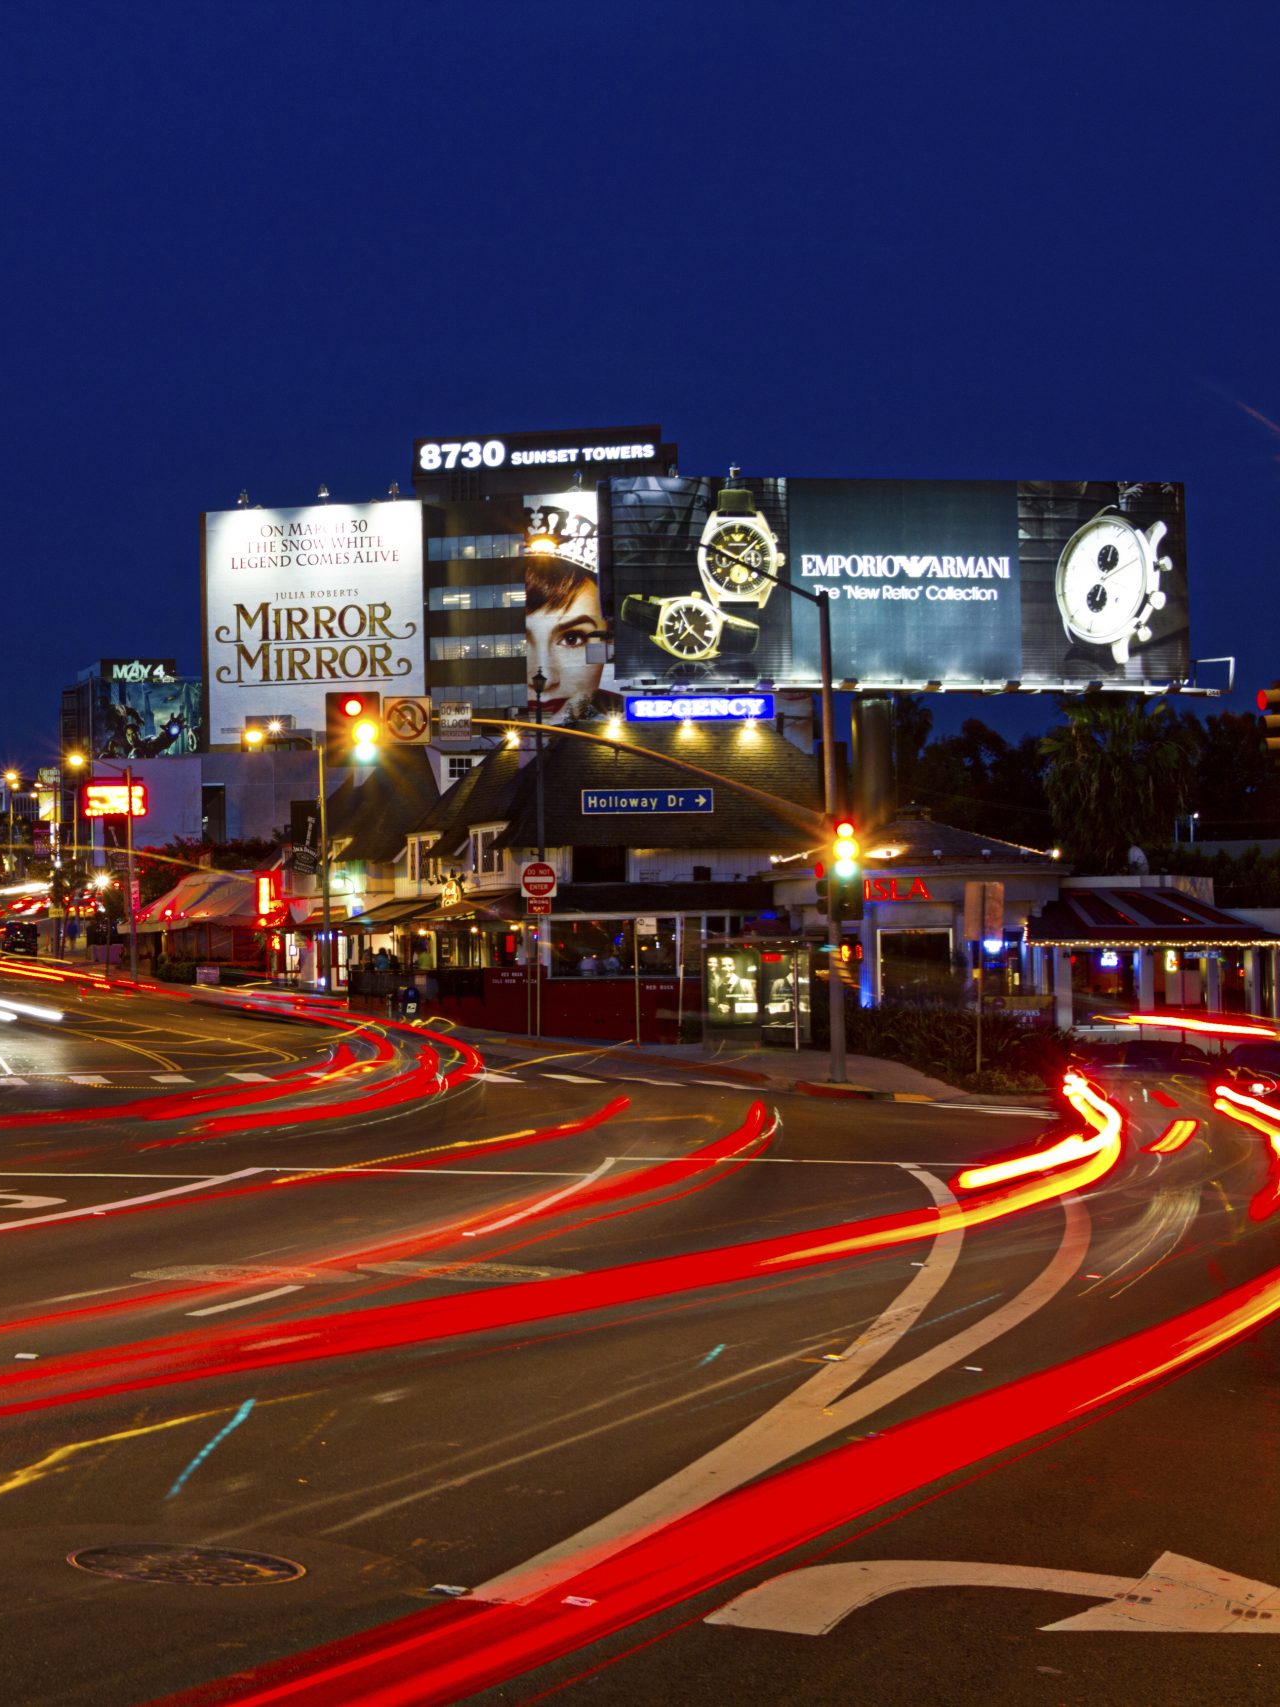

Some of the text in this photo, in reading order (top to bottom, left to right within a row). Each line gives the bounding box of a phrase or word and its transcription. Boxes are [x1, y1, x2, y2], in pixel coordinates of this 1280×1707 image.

[420, 440, 655, 470] 8730 SUNSET TOWERS
[260, 524, 284, 537] ON
[350, 519, 368, 533] 30
[246, 535, 384, 553] THE SNOW WHITE
[231, 550, 400, 570] LEGEND COMES ALIVE
[801, 555, 1010, 578] EMPORIO ARMANI
[275, 588, 360, 601] JULIA ROBERTS
[925, 584, 998, 600] Collection
[215, 601, 417, 643] MIRROR
[113, 660, 165, 682] MAY 4
[216, 642, 412, 683] MIRROR
[455, 706, 470, 716] NOT
[635, 699, 765, 717] REGENCY
[441, 719, 470, 728] BLOCK
[588, 795, 684, 810] Holloway Dr
[864, 876, 933, 902] ISLA
